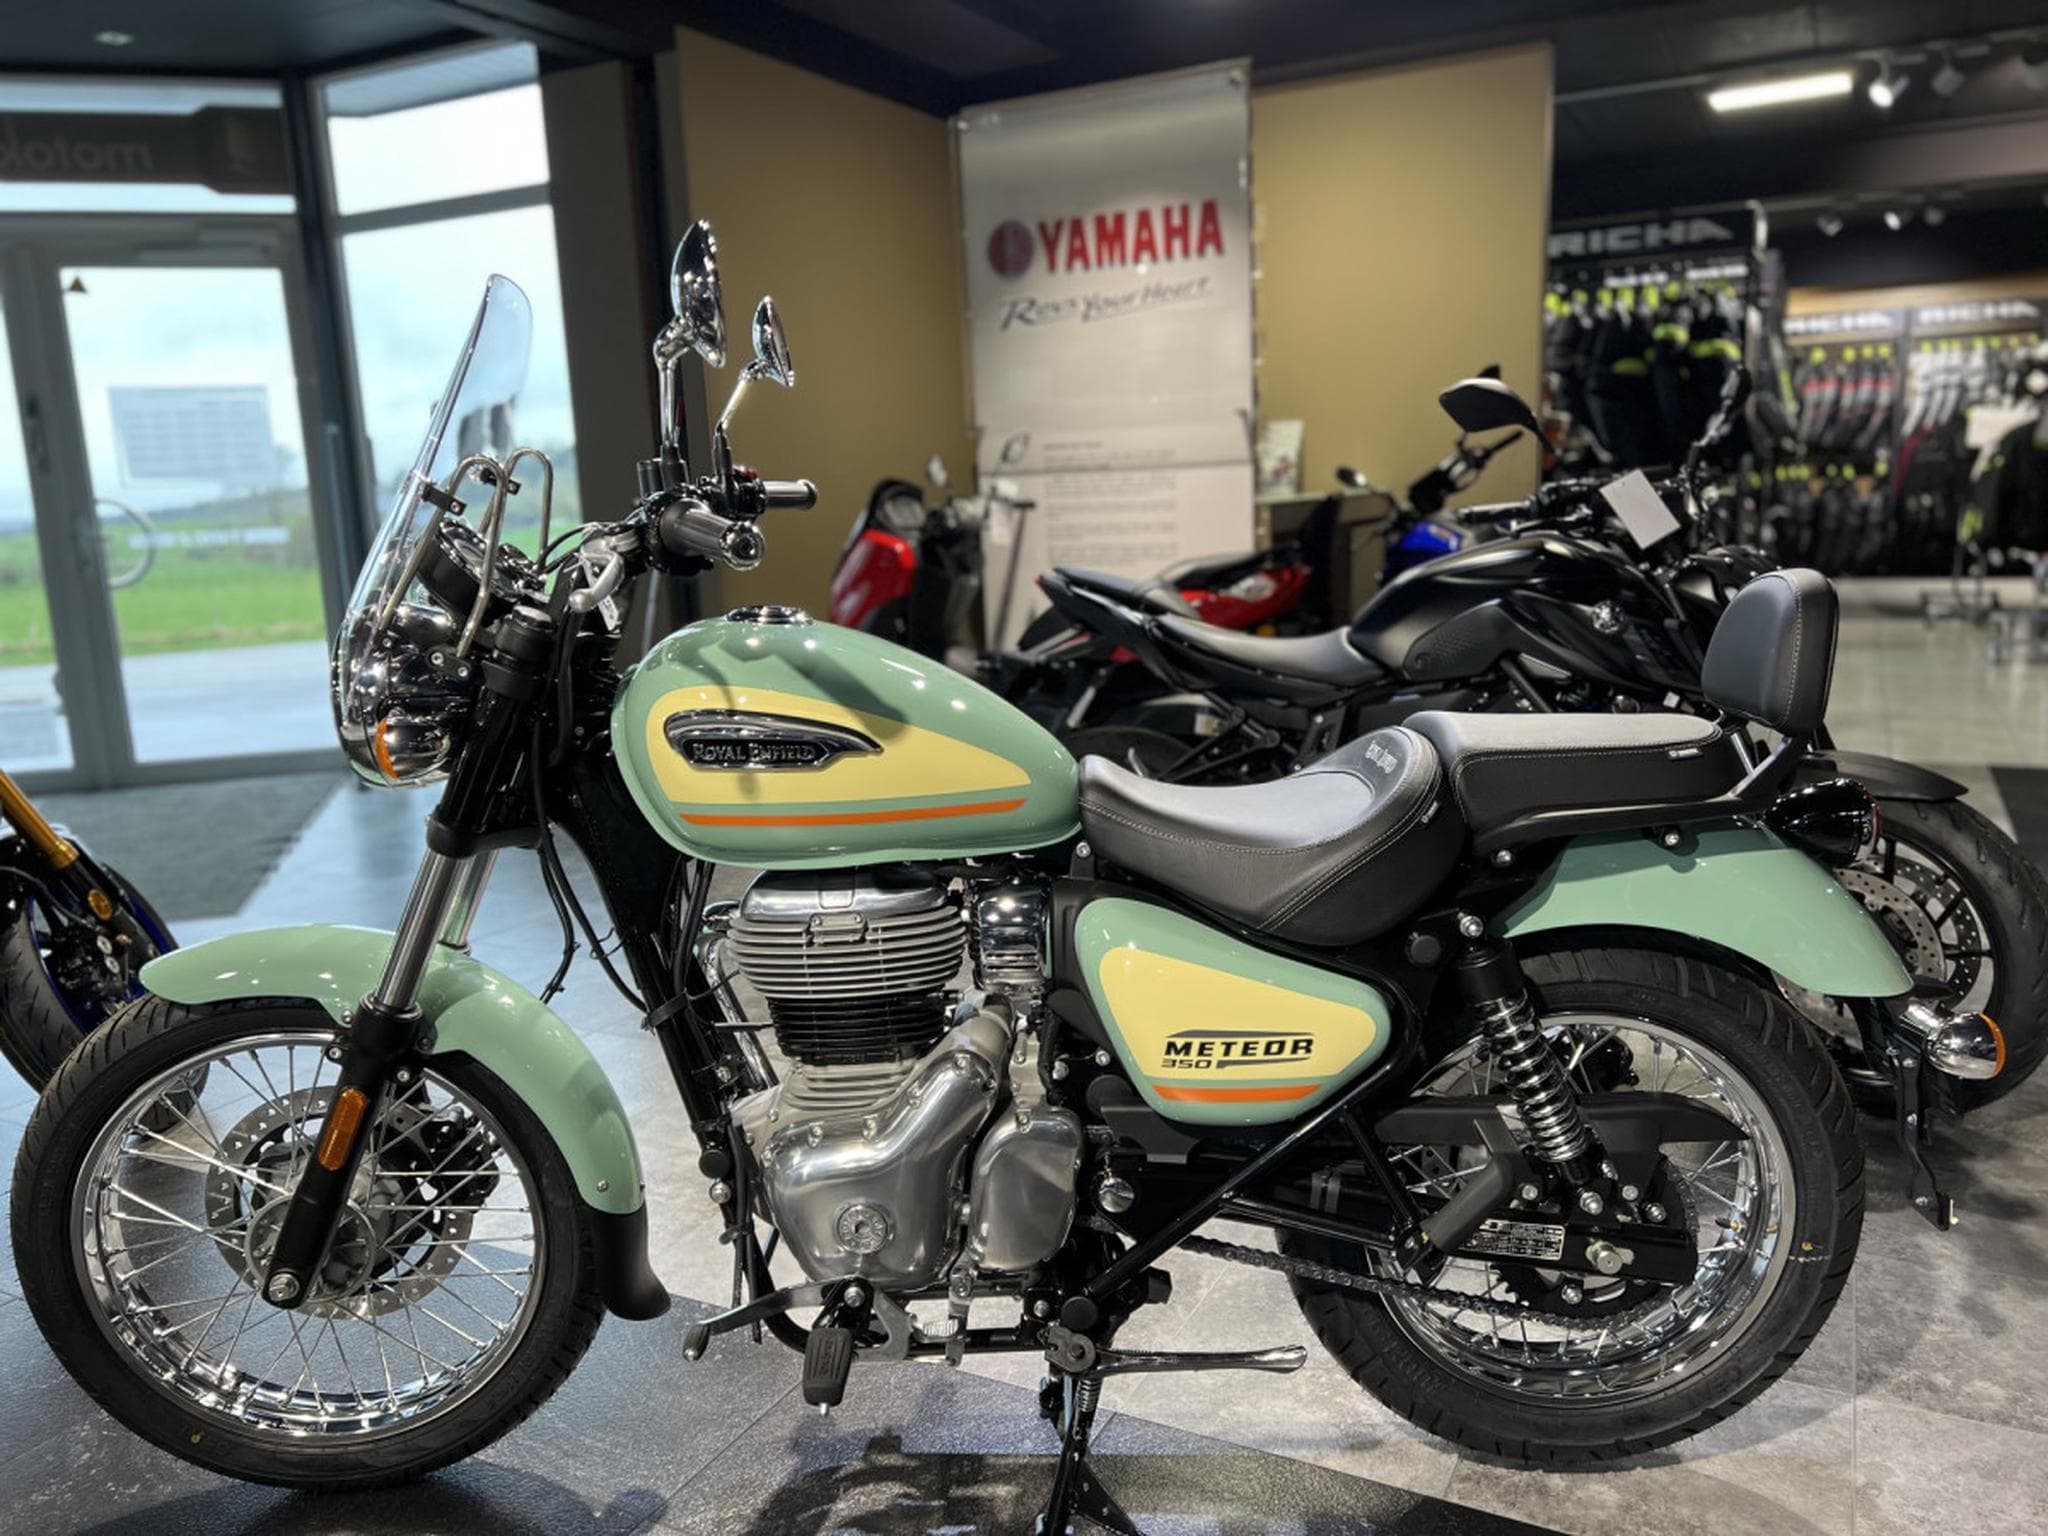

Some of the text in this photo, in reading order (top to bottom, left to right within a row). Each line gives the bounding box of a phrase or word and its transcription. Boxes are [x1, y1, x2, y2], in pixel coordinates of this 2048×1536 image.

[1037, 199, 1224, 275] YAMAHA
[1547, 217, 1736, 259] RICHA
[692, 742, 746, 761] ROYAL
[1164, 1038, 1314, 1057] METEOR
[1160, 1057, 1212, 1069] 350
